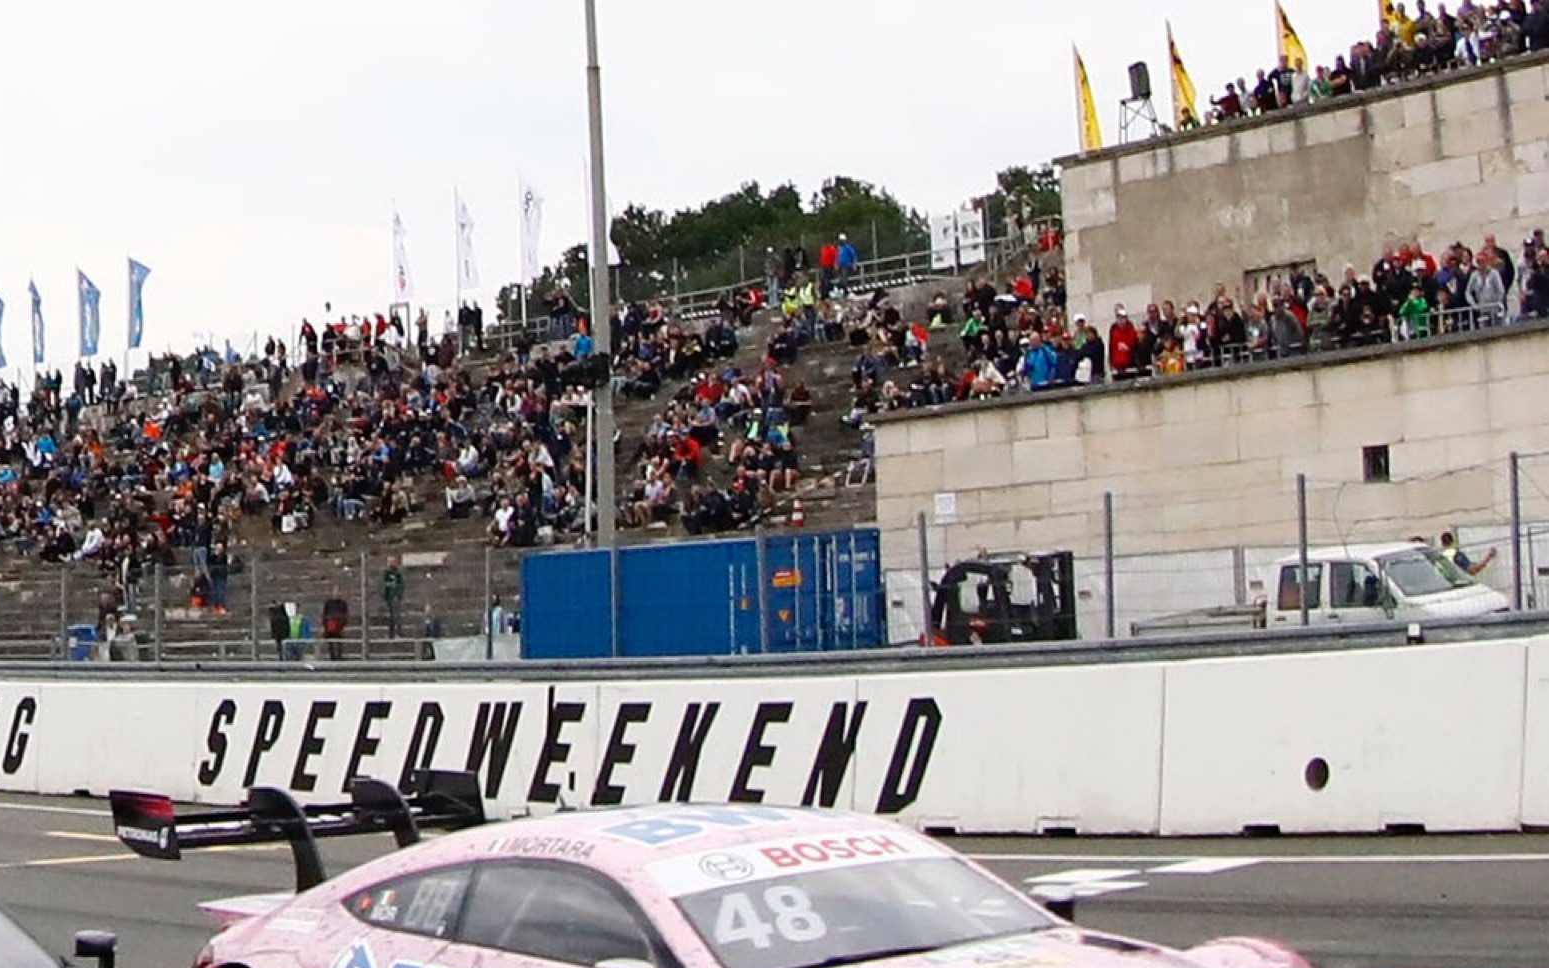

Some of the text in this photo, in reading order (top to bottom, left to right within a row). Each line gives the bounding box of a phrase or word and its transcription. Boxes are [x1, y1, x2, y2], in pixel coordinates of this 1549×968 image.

[197, 696, 942, 814] SPEEDWEEKEND
[760, 834, 908, 868] BOSCH
[715, 886, 827, 948] 48
